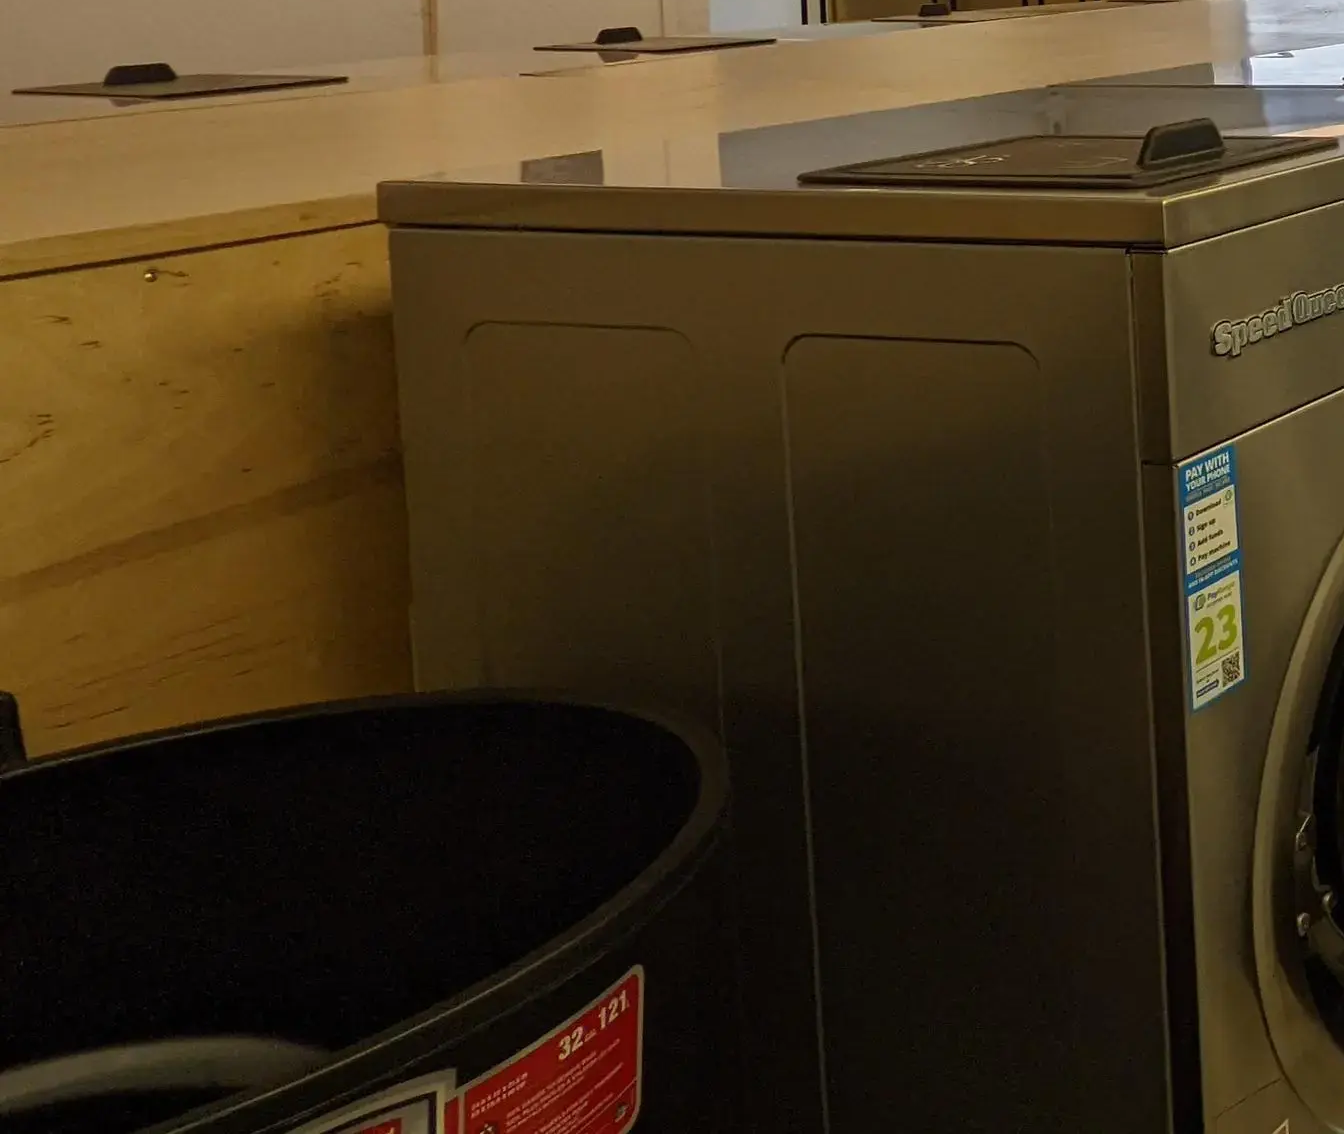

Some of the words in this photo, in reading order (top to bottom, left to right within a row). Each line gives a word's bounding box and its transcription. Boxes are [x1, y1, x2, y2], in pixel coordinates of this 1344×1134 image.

[1211, 297, 1293, 358] Speed
[1185, 463, 1204, 482] PAY
[1204, 451, 1230, 472] WITH
[1186, 474, 1207, 492] YOUR
[1206, 464, 1231, 483] PHONE
[1195, 498, 1222, 516] Download
[1196, 521, 1208, 533] Sign
[1208, 517, 1216, 527] up
[1197, 551, 1208, 563] Pay
[1208, 540, 1231, 556] machine
[1194, 604, 1238, 665] 23
[558, 1026, 584, 1061] 32
[599, 989, 628, 1031] 121
